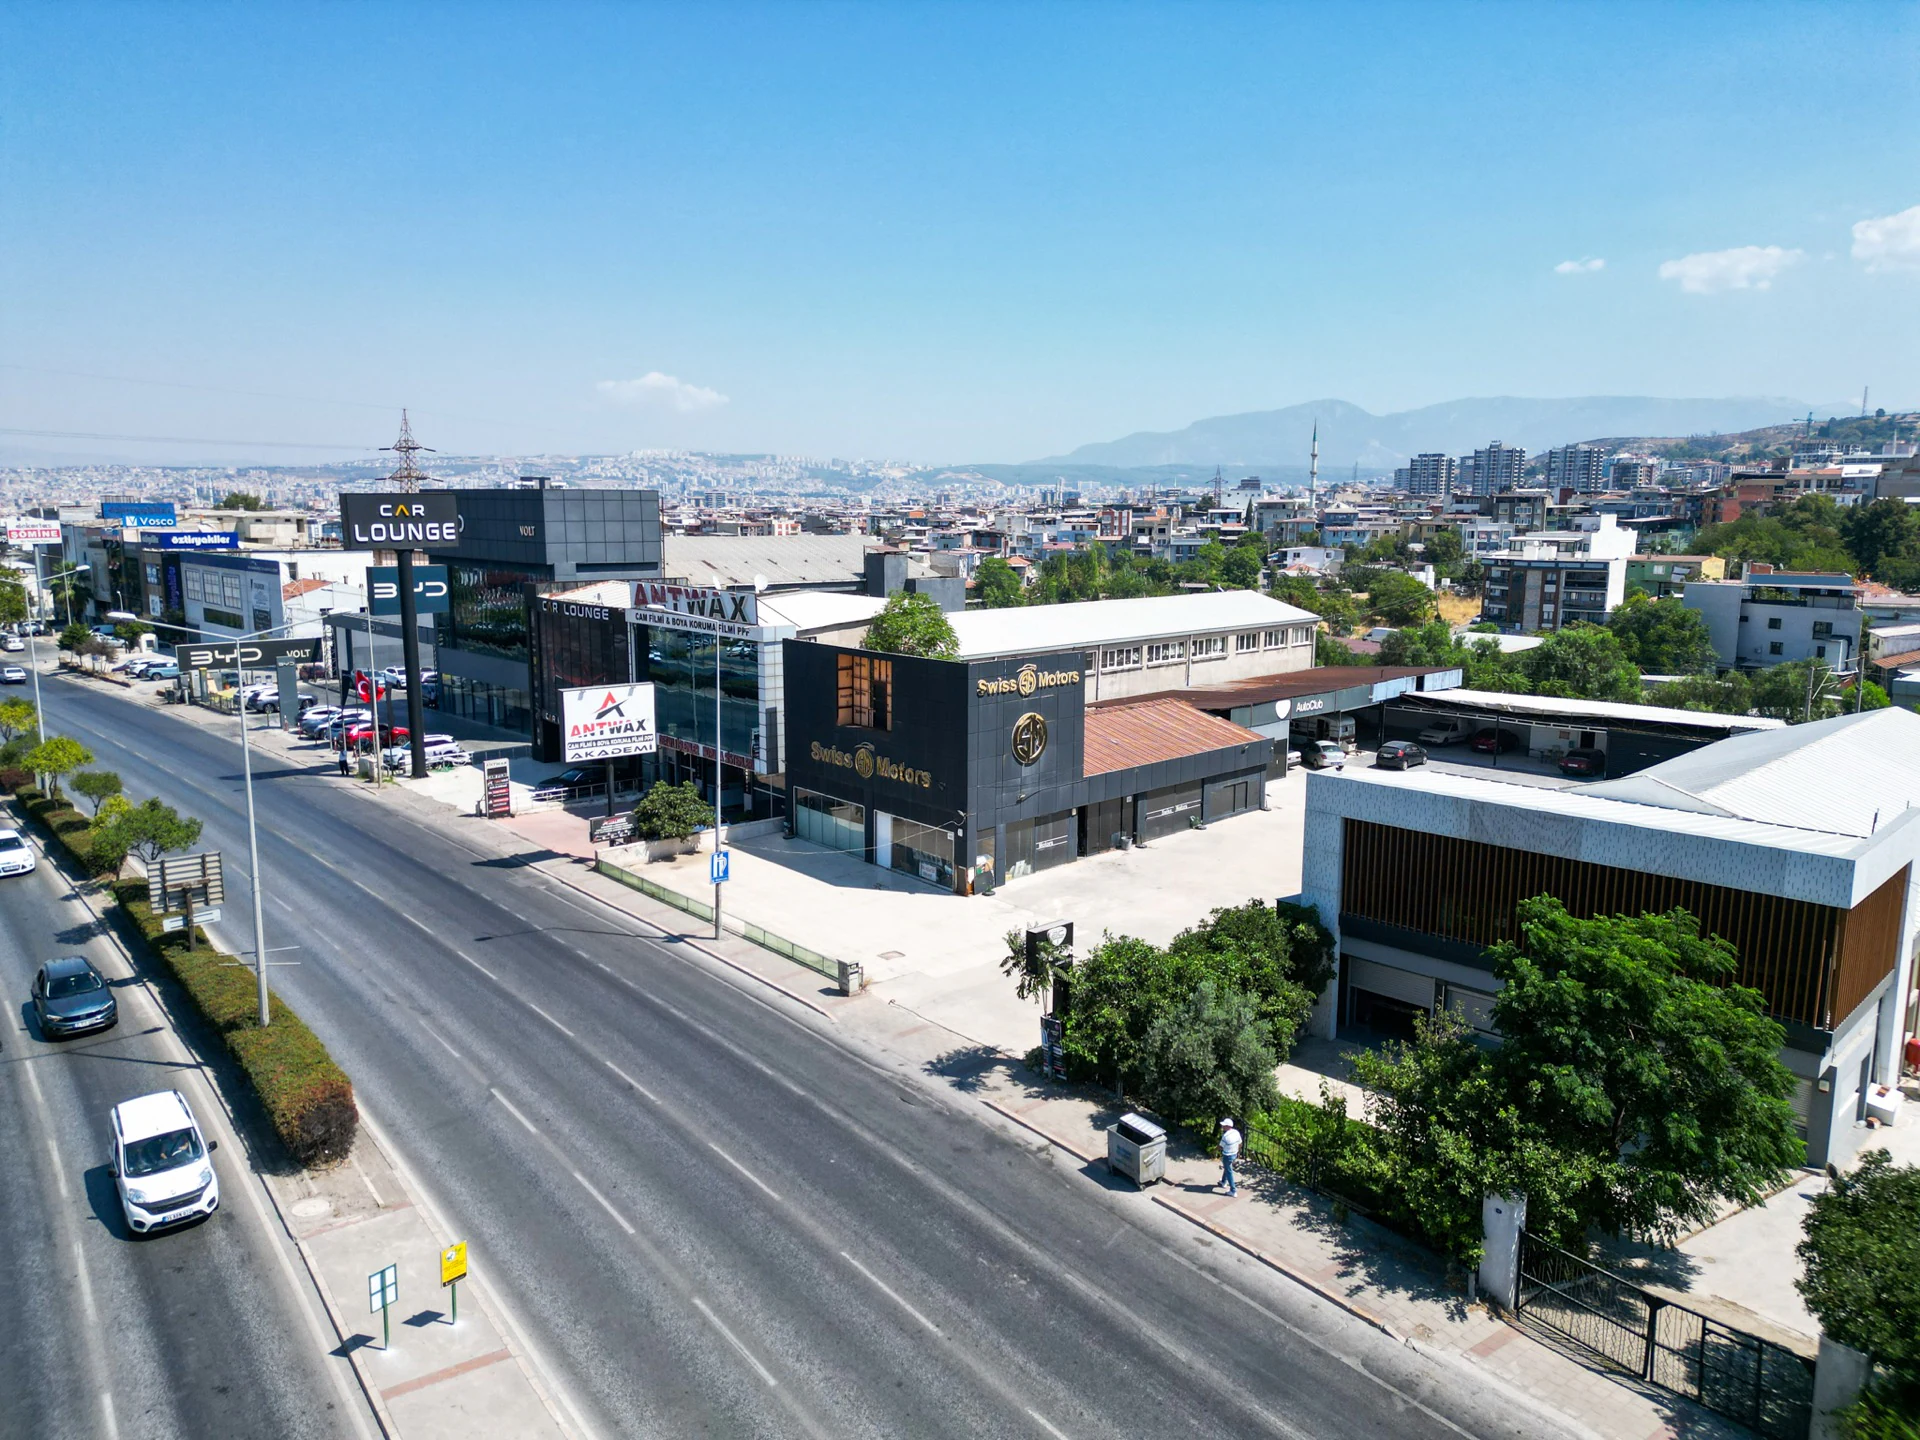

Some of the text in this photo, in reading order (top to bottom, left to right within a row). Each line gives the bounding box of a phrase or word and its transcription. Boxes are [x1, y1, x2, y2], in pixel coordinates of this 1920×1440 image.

[379, 504, 425, 517] CAR
[139, 517, 174, 526] Vosco
[354, 522, 457, 542] LOUNGE
[519, 525, 536, 537] VOLT
[170, 535, 231, 547] öztiryakiler
[634, 583, 748, 622] ANTWAX
[563, 603, 610, 621] LOUNGE
[635, 612, 648, 621] CAM
[671, 617, 688, 628] BOYA
[689, 619, 717, 632] KORUMA
[190, 647, 311, 666] BYD VOLT
[977, 677, 1018, 695] Swiss
[1037, 670, 1080, 688] Motors
[1295, 698, 1324, 713] AutoClub
[570, 718, 647, 738] ANTWAX
[571, 744, 653, 760] AKADEMİ
[810, 741, 854, 769] Swiss
[875, 754, 932, 789] Motors
